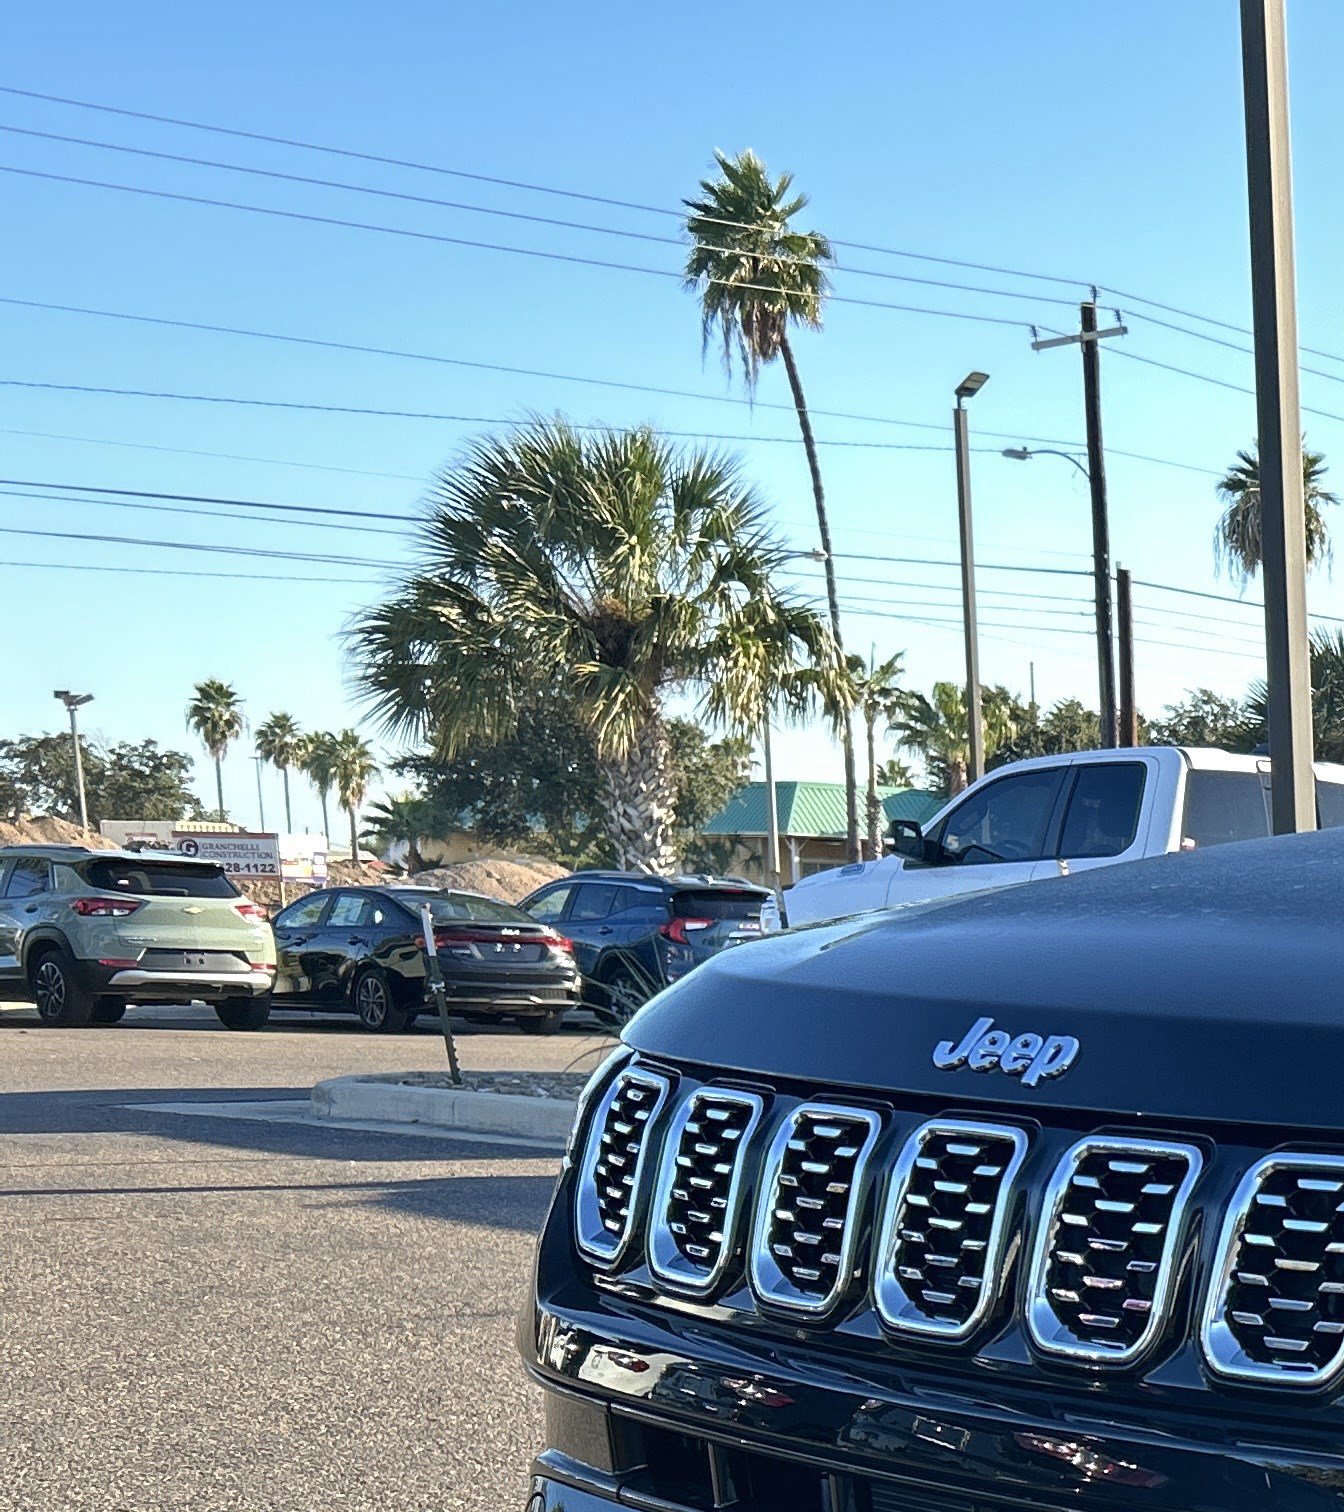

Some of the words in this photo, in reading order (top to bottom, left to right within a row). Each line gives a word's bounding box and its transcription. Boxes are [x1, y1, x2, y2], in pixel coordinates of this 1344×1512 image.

[202, 850, 274, 860] CONSTRUCTION
[226, 863, 276, 873] 28-1122
[932, 1016, 1080, 1089] Jeep
